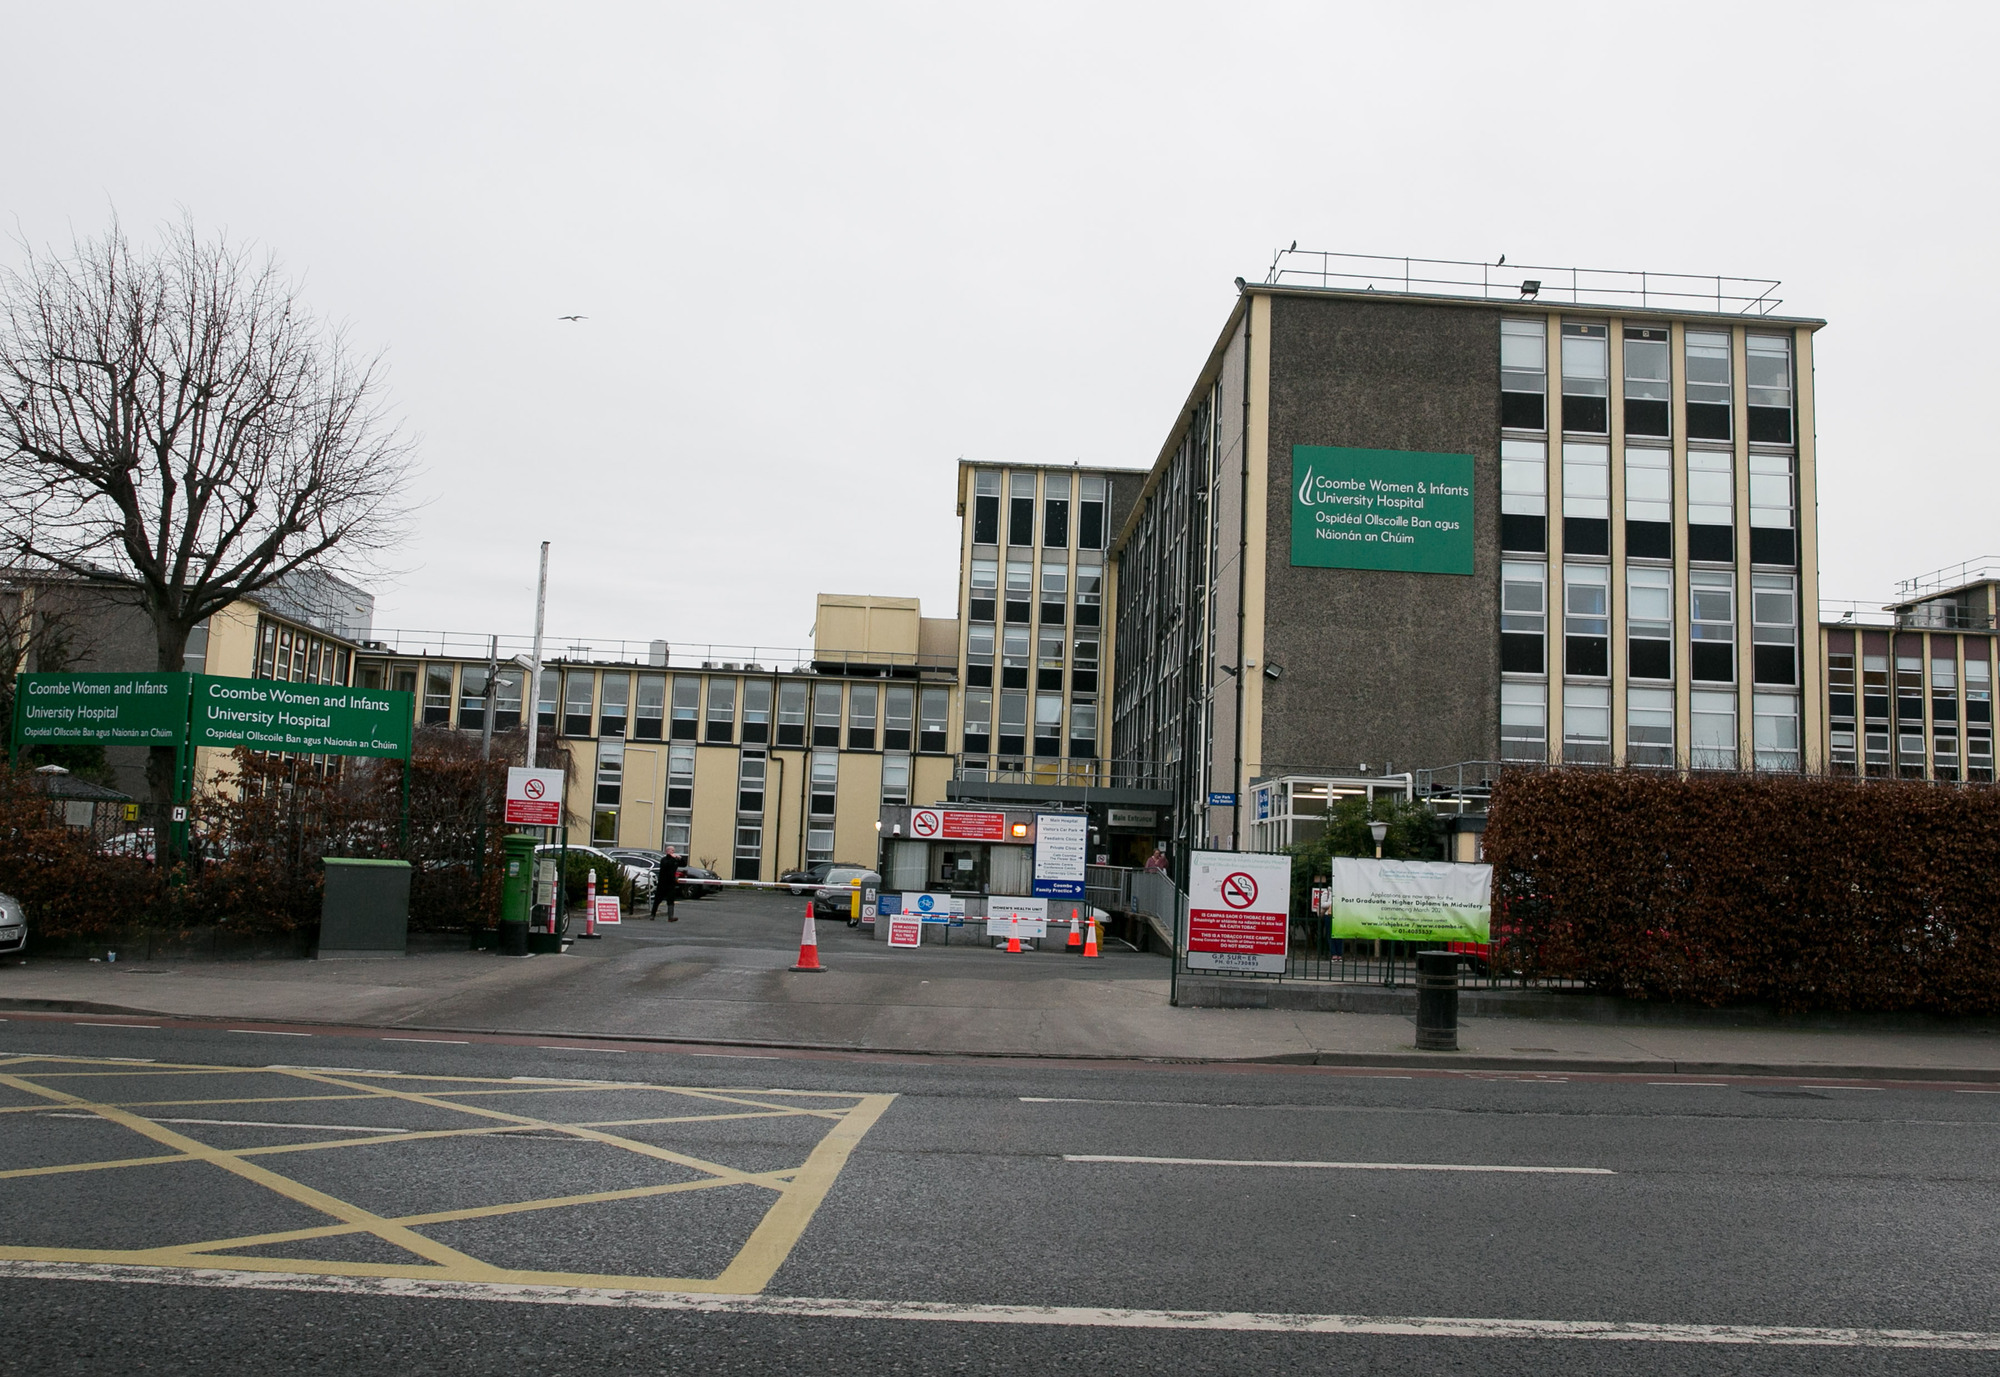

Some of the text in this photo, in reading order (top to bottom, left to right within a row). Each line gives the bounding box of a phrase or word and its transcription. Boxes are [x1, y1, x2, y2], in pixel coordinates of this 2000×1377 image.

[1316, 476, 1469, 496] Coombe Women & Infants
[1316, 491, 1424, 510] University Hospital
[1316, 511, 1362, 525] Ospidéal
[1411, 516, 1432, 528] Ban
[1434, 521, 1460, 532] agus
[1316, 528, 1414, 544] Náionán an Chúim
[28, 681, 168, 695] Coombe Women and Infants
[209, 684, 390, 712] Coombe Women and Infants
[26, 705, 119, 722] University Hospital
[207, 705, 331, 729] University Hospital
[24, 727, 51, 738] Ospidéal
[53, 727, 81, 737] Ollscoile
[83, 727, 94, 737] Ban
[96, 729, 110, 739] agus
[150, 728, 173, 737] Chúim
[205, 728, 244, 741] Ospidéal
[246, 731, 283, 742] Ollscoile
[286, 734, 301, 743] Ban
[303, 737, 322, 747] agus
[371, 739, 398, 750] Chúim
[126, 805, 136, 819] H
[175, 809, 184, 819] H
[1451, 902, 1483, 910] Midwifery
